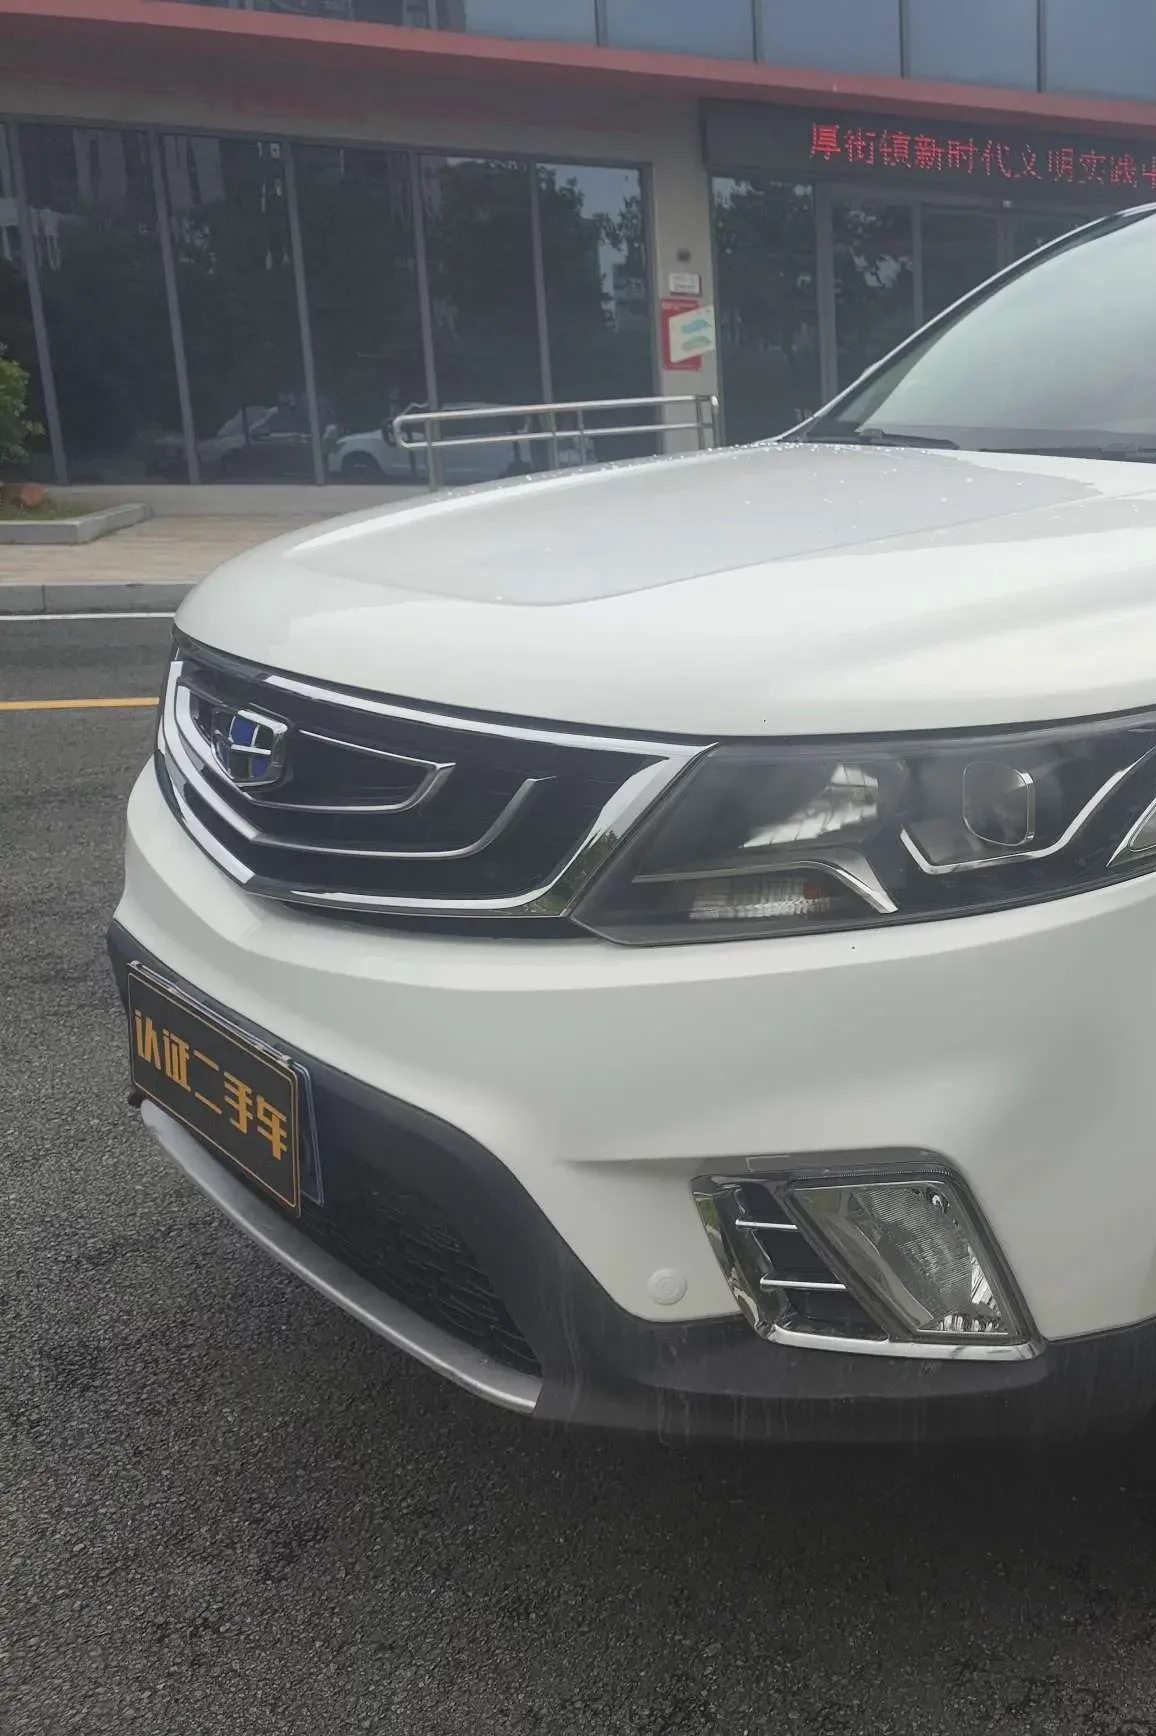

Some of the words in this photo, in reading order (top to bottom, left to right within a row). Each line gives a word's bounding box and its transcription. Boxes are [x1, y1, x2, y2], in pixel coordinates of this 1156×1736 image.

[134, 1008, 288, 1161] 认证二手车
